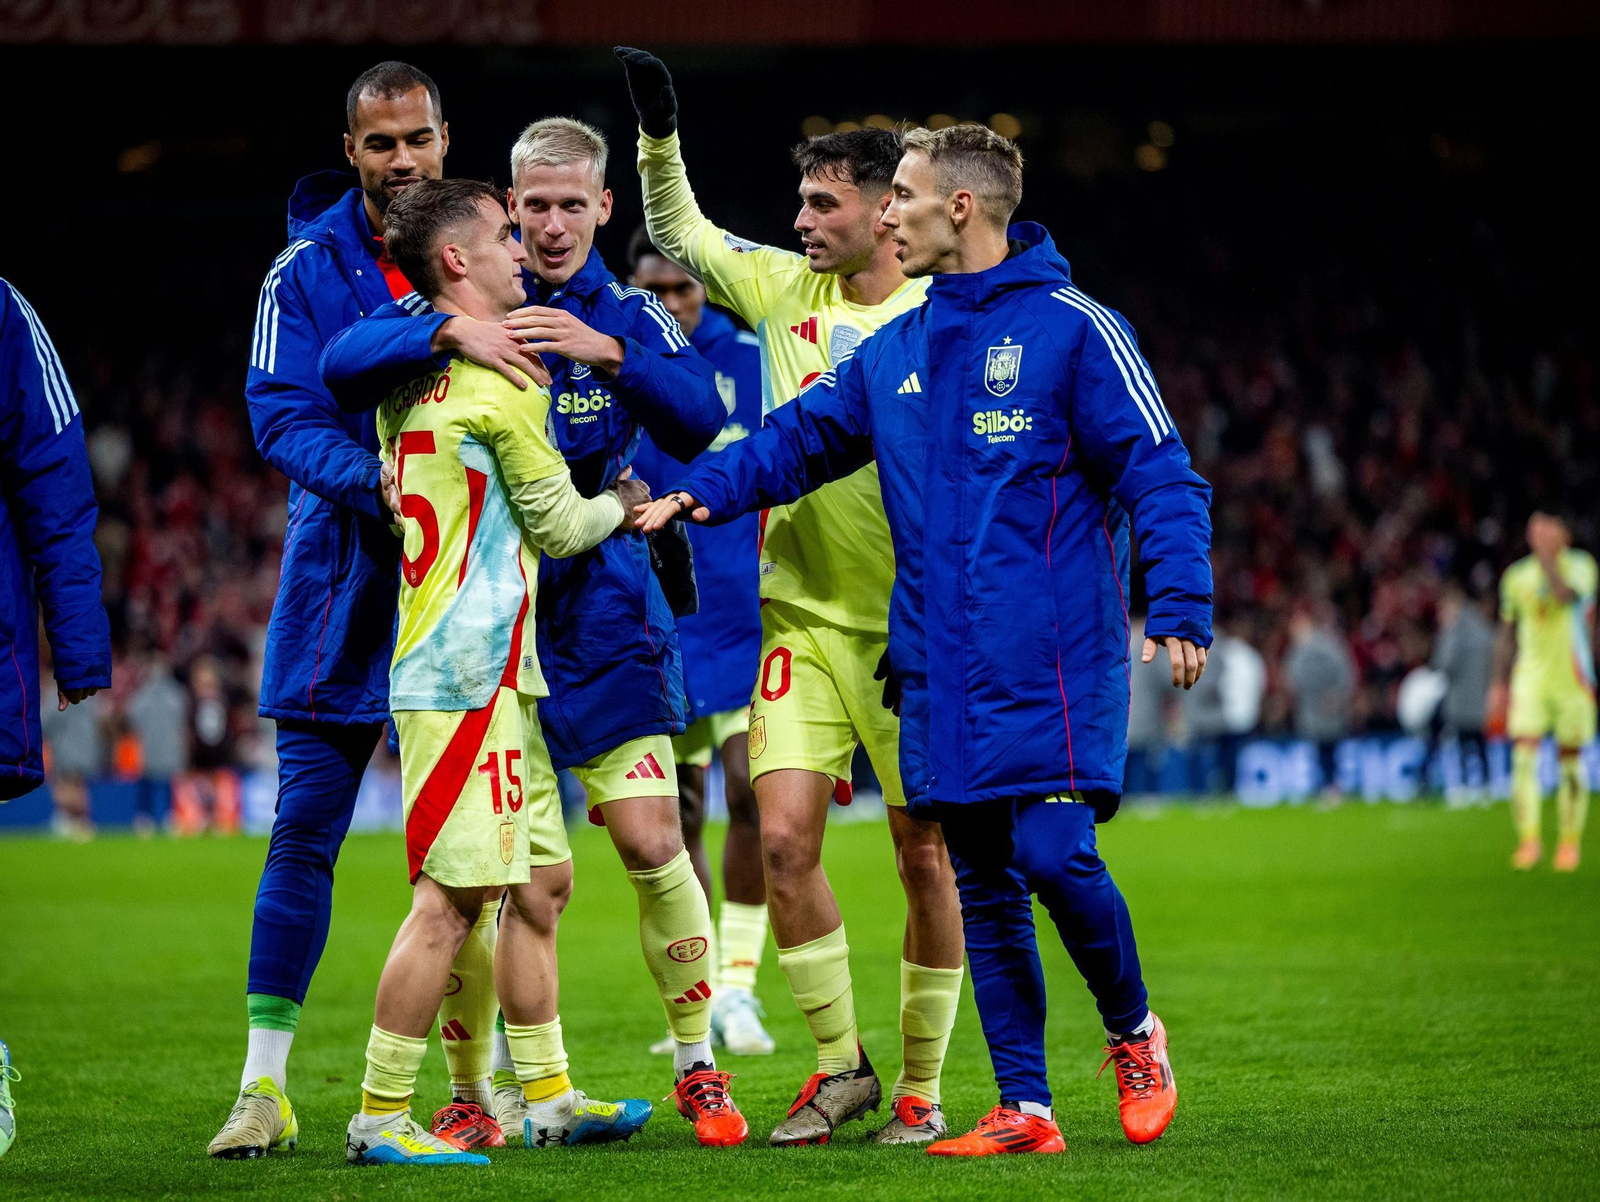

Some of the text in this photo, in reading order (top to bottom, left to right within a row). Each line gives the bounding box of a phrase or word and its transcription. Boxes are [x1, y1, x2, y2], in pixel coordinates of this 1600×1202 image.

[987, 435, 1015, 444] Telecom
[390, 430, 440, 588] 5
[478, 749, 523, 815] 15
